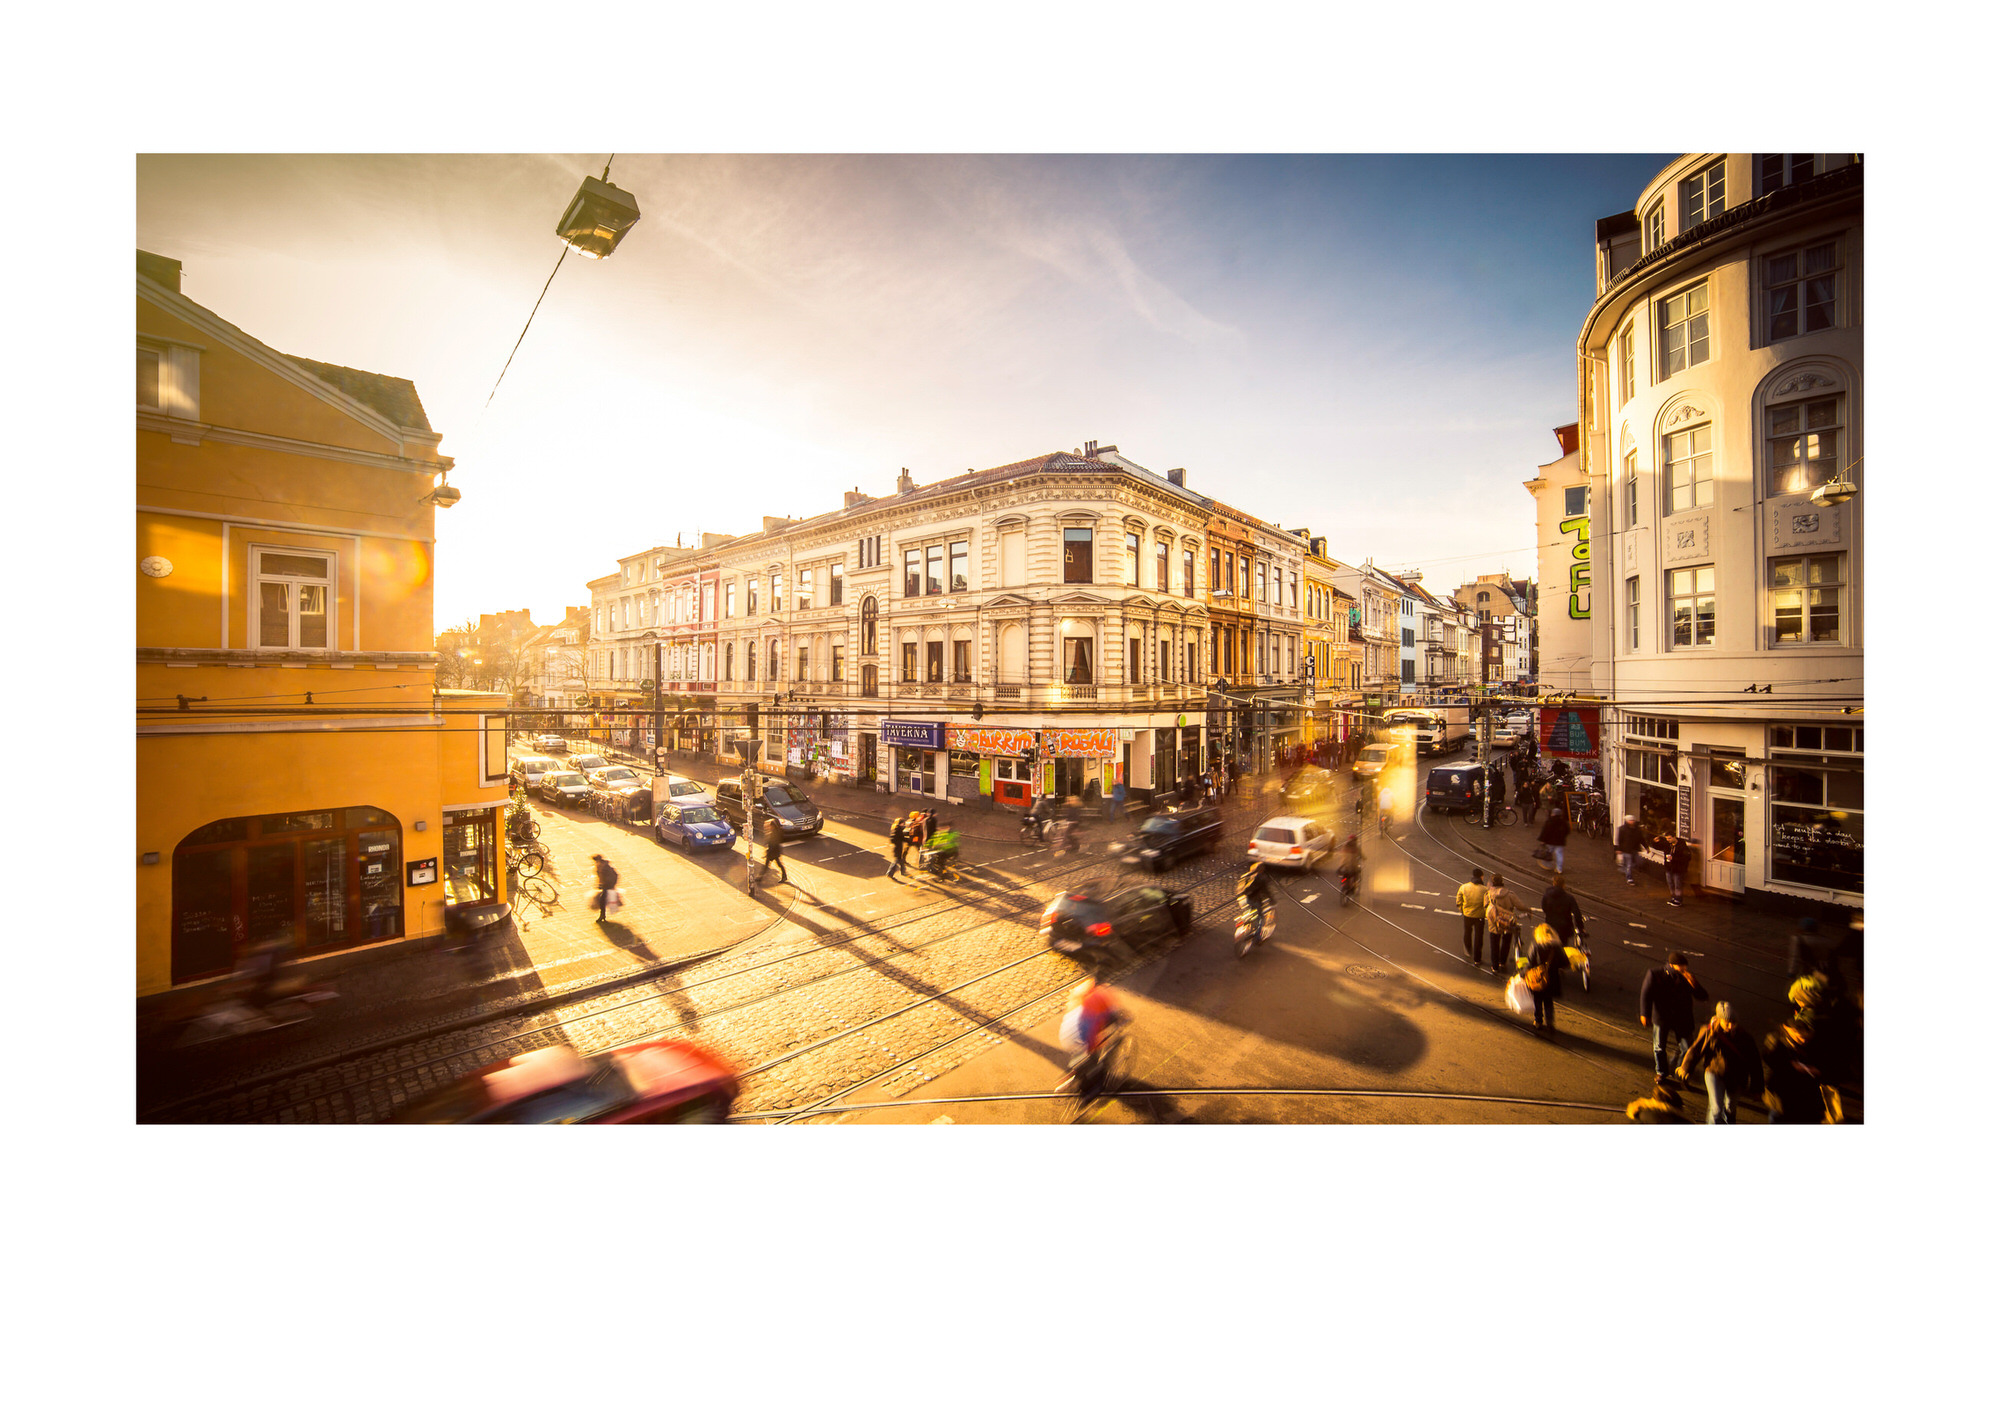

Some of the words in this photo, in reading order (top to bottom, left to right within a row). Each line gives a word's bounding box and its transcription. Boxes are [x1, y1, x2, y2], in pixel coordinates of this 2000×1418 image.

[1305, 656, 1315, 717] CINEMA
[886, 724, 929, 739] TAVERNA
[1781, 832, 1804, 843] keeps
